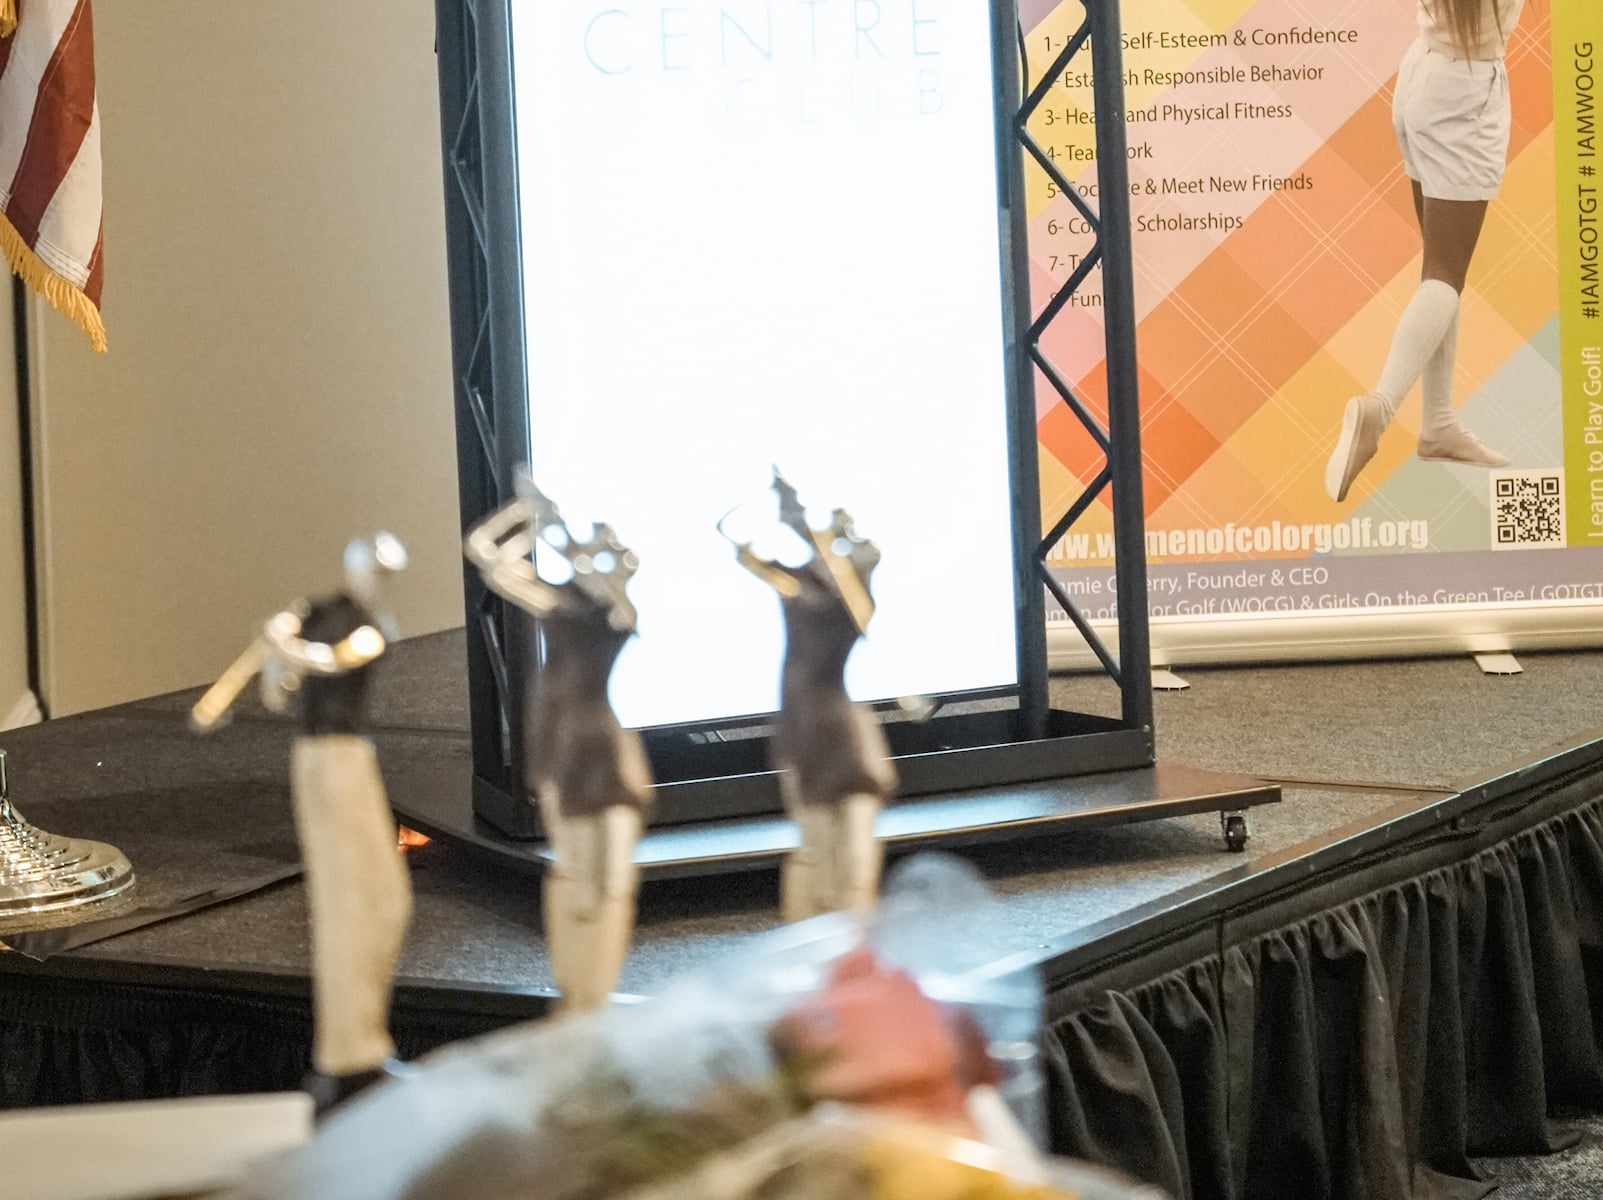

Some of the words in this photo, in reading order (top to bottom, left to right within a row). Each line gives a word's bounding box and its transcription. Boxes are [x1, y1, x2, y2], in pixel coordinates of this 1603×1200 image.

[1121, 31, 1228, 50] Self-Esteem
[1233, 30, 1247, 47] &
[1251, 27, 1358, 46] Confidence
[1144, 66, 1246, 92] Responsible
[1250, 64, 1325, 83] Behavior
[1575, 41, 1595, 157] IAMWOCG
[1126, 105, 1157, 122] and
[1162, 102, 1230, 126] Physical
[1234, 101, 1293, 119] Fitness
[1145, 178, 1157, 195] &
[1162, 177, 1205, 194] Meet
[1210, 175, 1248, 193] New
[1252, 173, 1314, 192] Friends
[1137, 213, 1244, 233] Scholarships
[1579, 183, 1600, 319] #IAMGOTGT
[1581, 346, 1602, 397] Golf!
[1584, 400, 1603, 445] Play
[1587, 450, 1603, 473] to
[1187, 569, 1267, 590] Founder
[1270, 568, 1285, 587] &
[1289, 567, 1329, 586] CEO
[1176, 598, 1217, 616] Golf
[1220, 596, 1295, 615] (WOCG)
[1300, 594, 1314, 610] &
[1318, 592, 1360, 609] Girls
[1364, 591, 1392, 607] On
[1397, 590, 1428, 606] the
[1433, 589, 1489, 604] Green
[1493, 586, 1525, 602] Tee
